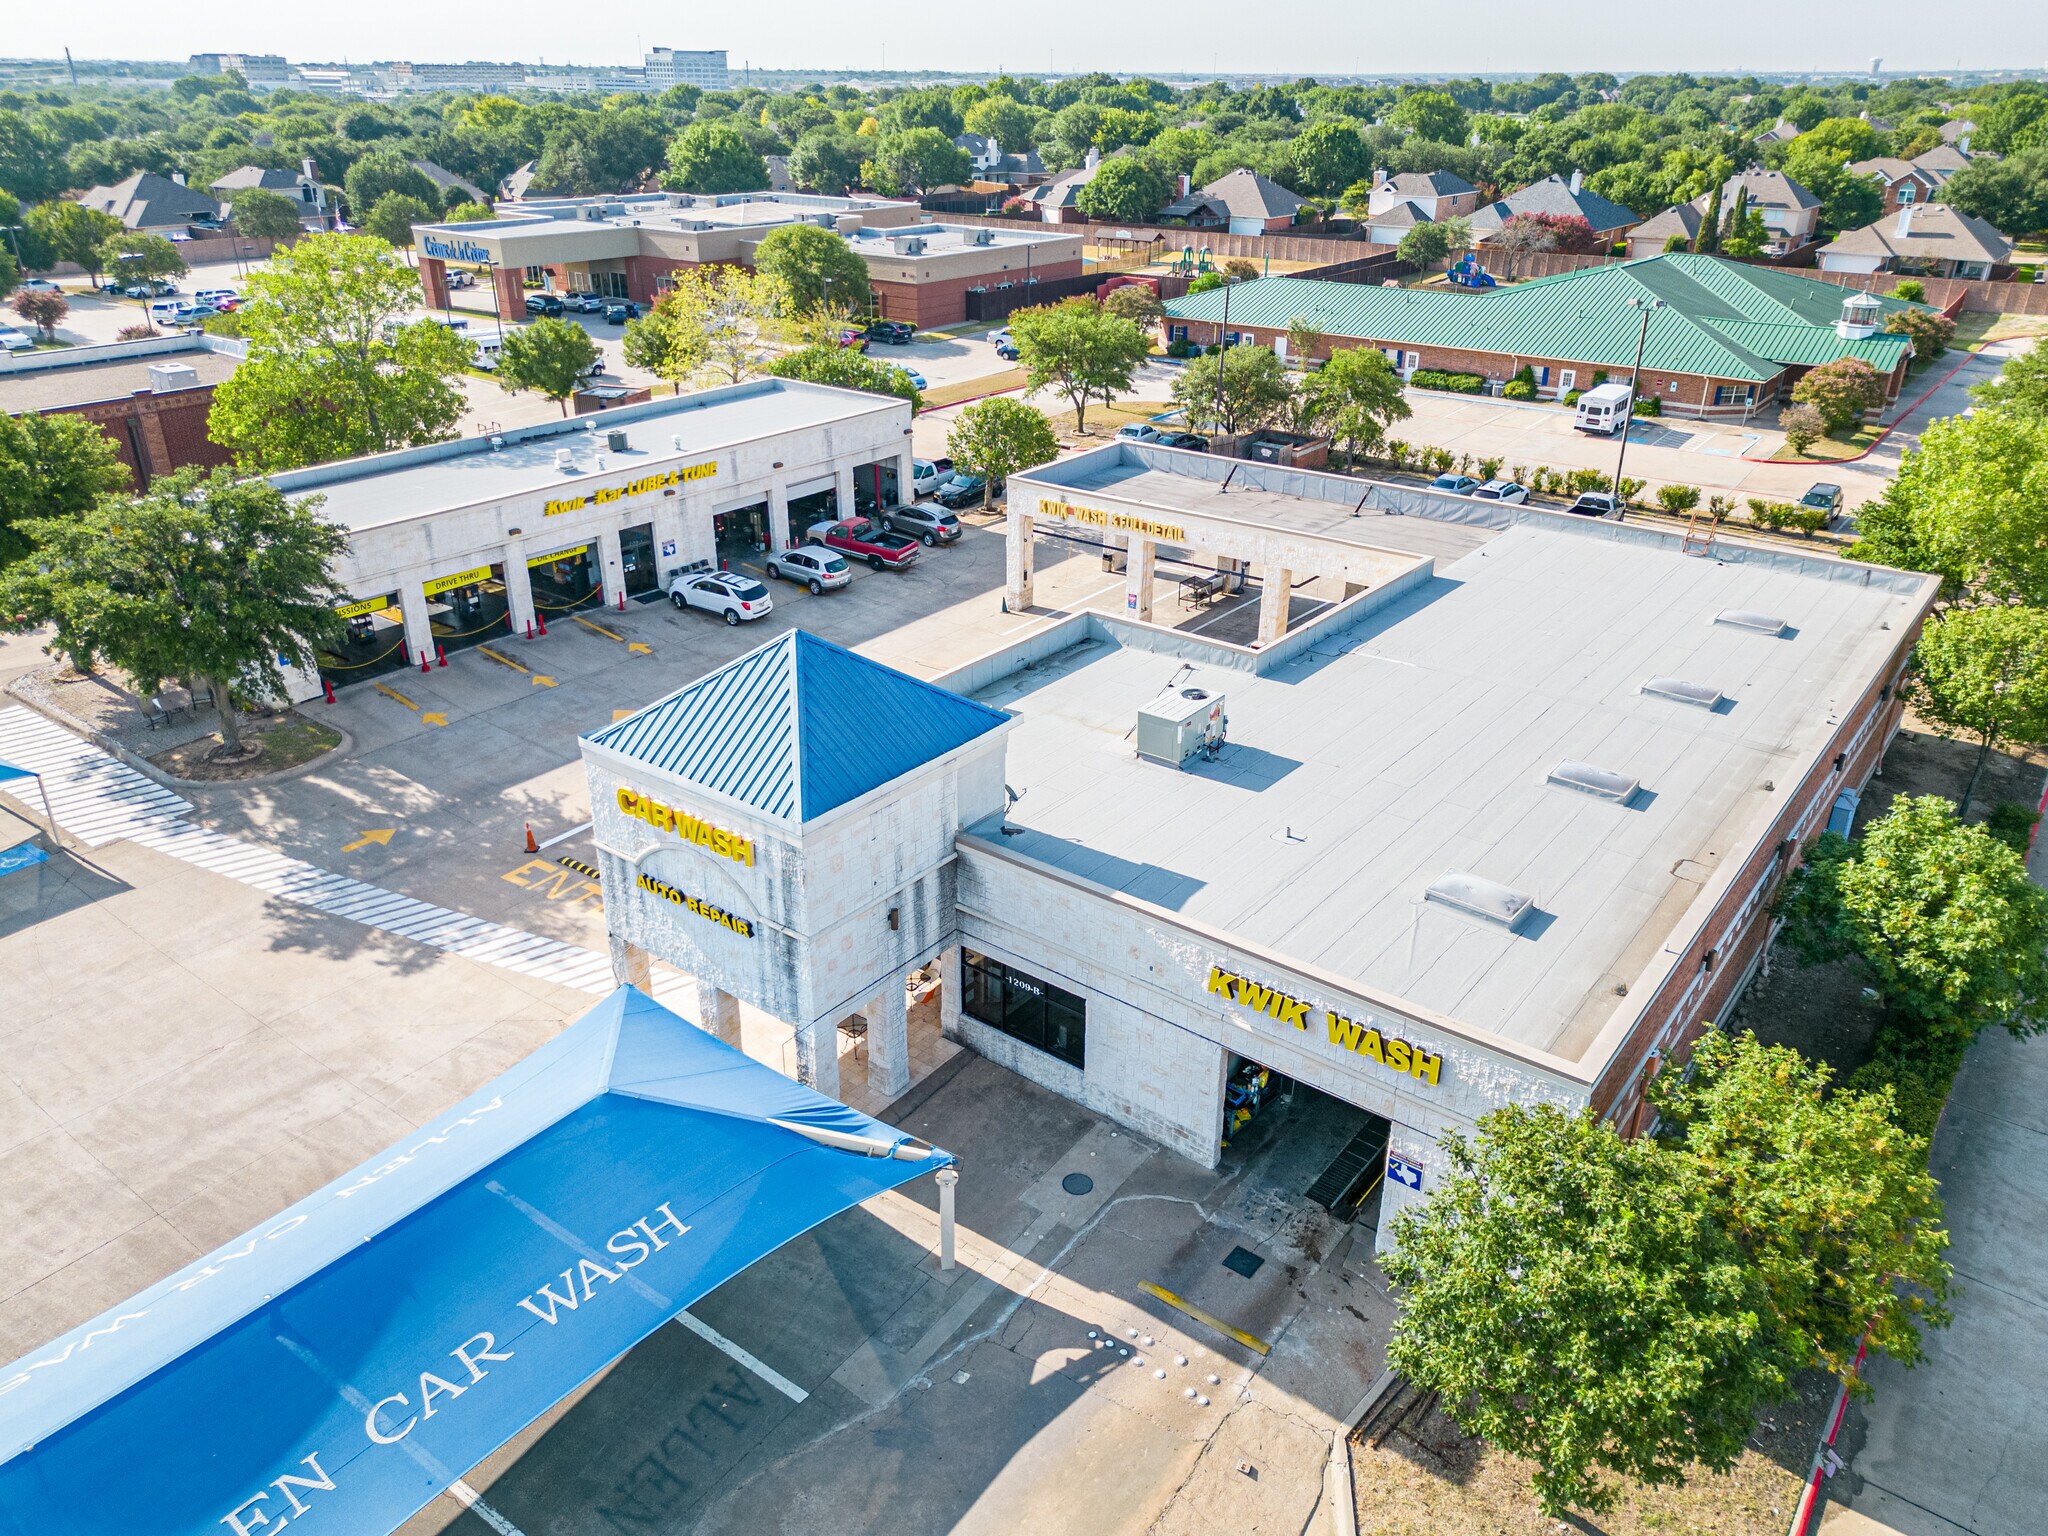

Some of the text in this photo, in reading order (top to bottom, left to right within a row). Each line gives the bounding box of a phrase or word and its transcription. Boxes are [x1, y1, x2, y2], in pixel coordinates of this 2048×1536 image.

[544, 461, 718, 517] Kwik Kar LUBE & TUNE
[1038, 499, 1185, 542] KWIK WASH & FULL DETAIL
[435, 571, 480, 590] DRIVE THRU
[617, 786, 756, 867] CAR WASH
[636, 873, 755, 938] AUTO REPAIR
[1208, 965, 1443, 1086] KWIK WASH
[336, 1096, 504, 1198] ALLEN
[179, 1215, 308, 1291] CAR
[365, 1331, 515, 1445] CAR
[517, 1201, 692, 1326] WASH
